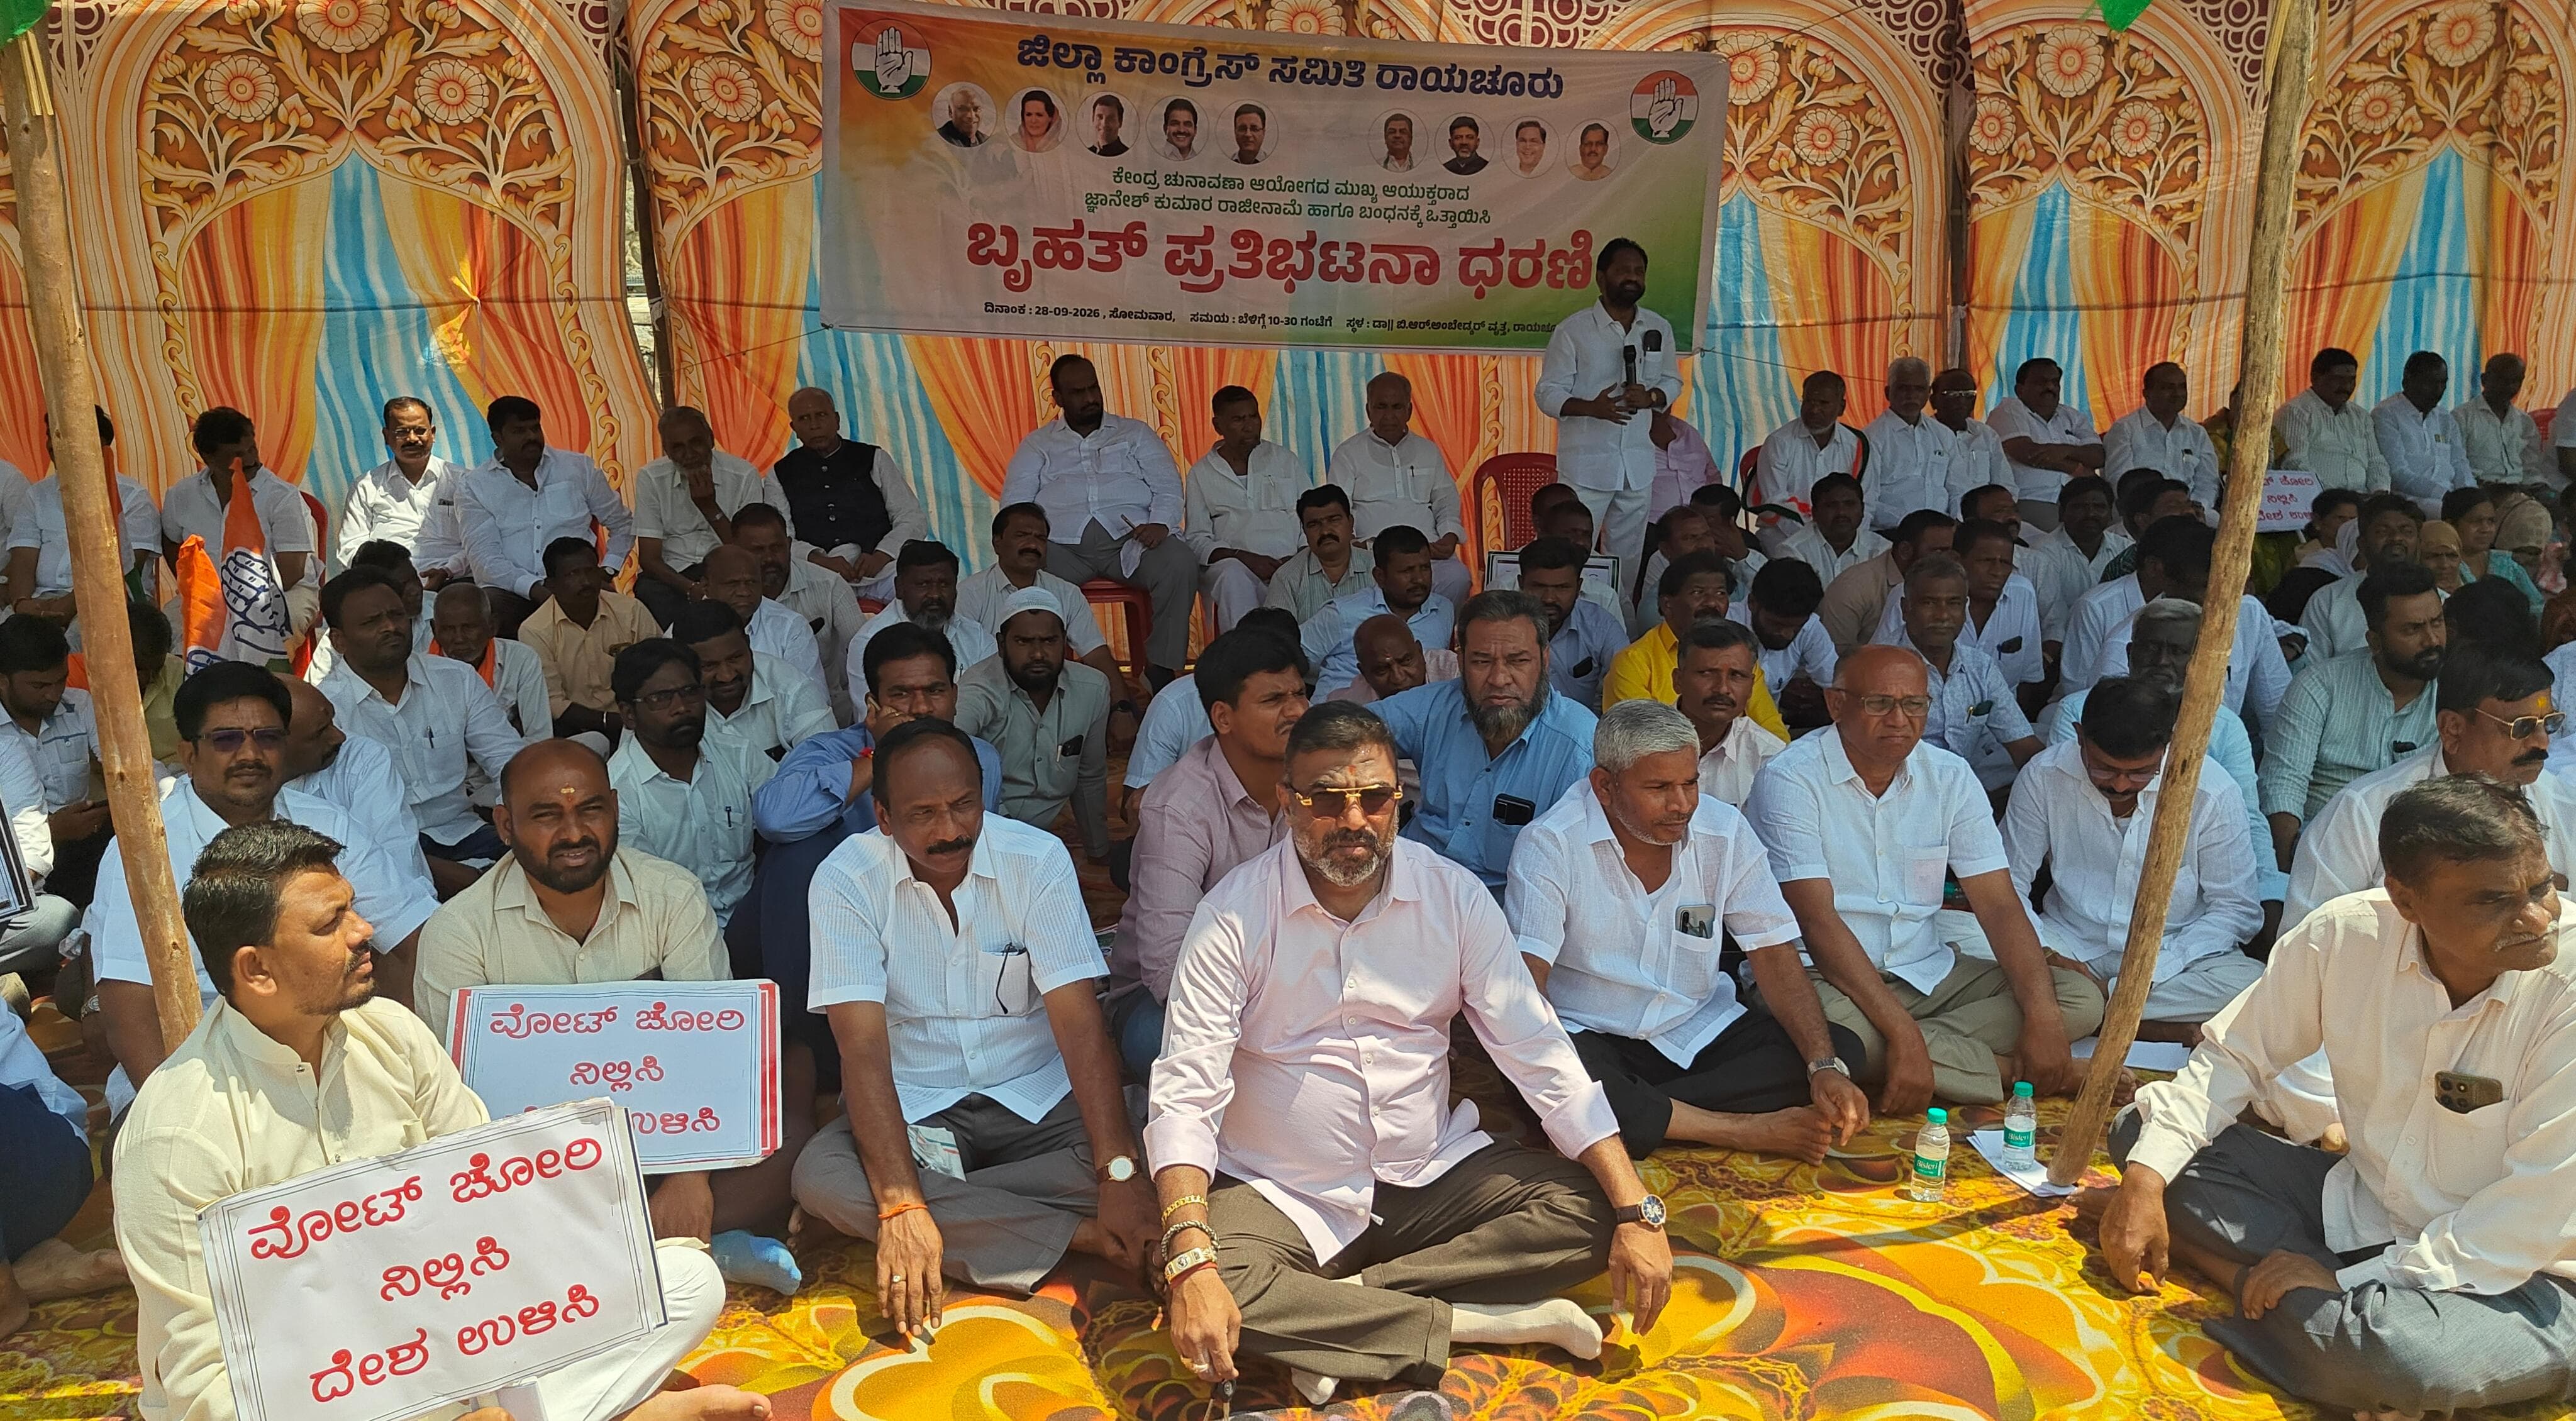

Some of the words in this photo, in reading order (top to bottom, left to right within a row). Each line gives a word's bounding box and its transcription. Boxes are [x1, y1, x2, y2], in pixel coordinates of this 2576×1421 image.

[1017, 35, 1106, 84] ಜಿಲ್ಲಾ
[1113, 47, 1260, 87] ಕಾಂಗ್ರೆಸ್
[1269, 56, 1366, 87] ಸಮಿತಿ
[1376, 63, 1563, 99] ರಾಯಚೂರು
[1085, 190, 1150, 214] ಜ್ಞಾನೇಶ್
[1154, 194, 1213, 212] ಕುಮಾರ
[1218, 199, 1302, 216] ರಾಜೀನಾಮೆ
[1307, 202, 1354, 218] ಹಾಗೂ
[1359, 205, 1423, 228] ಬಂಧನಕ್ಕೆ
[1426, 209, 1491, 229] ಒತ್ತಾಯಿಸಿ
[1113, 167, 1159, 190] ಕೇಂದ್ರ
[1164, 171, 1245, 189] ಚುನಾವಣಾ
[1250, 175, 1329, 195] ಆಯೋಗದ
[1335, 180, 1378, 203] ಮುಖ್ಯ
[1382, 183, 1470, 206] ಆಯುಕ್ತರಾದ
[967, 218, 1147, 293] ಬೃಹತ್
[1163, 224, 1441, 294] ಪ್ರತಿಭಟನಾ
[1458, 229, 1594, 301] ಧರಣಿ
[1035, 306, 1100, 318] 28-09-2026
[1190, 312, 1230, 323] ಸಮಯ
[1268, 316, 1298, 326] 10-30
[489, 1004, 619, 1039] ವೋಟ್
[635, 1001, 745, 1031] ಚೋರಿ
[570, 1054, 665, 1092] ನಿಲ್ಲಿಸಿ
[248, 1175, 423, 1260] ವೋಟ್
[449, 1137, 603, 1203] ಚೋರಿ
[380, 1236, 511, 1301] ನಿಲ್ಲಿಸಿ
[309, 1327, 429, 1403] ದೇಶ
[457, 1284, 601, 1356] ಉಳಿಸಿ
